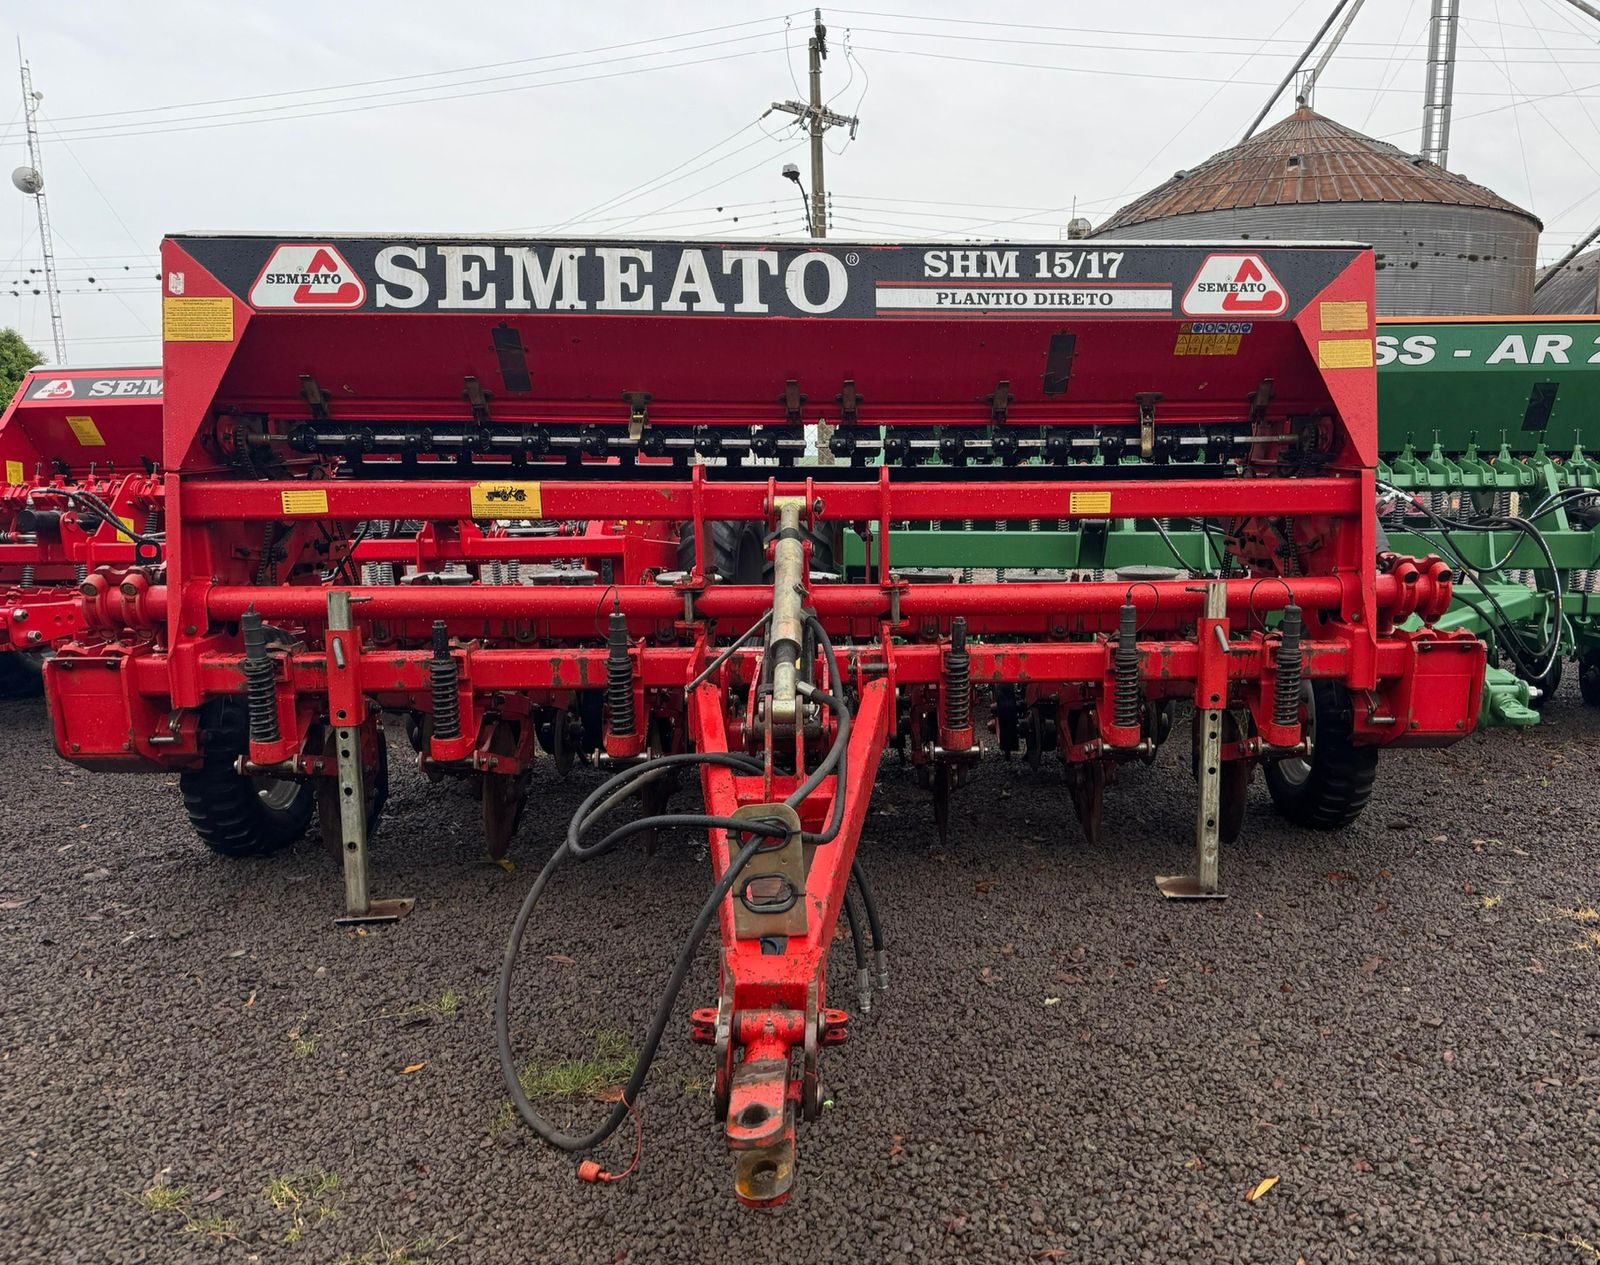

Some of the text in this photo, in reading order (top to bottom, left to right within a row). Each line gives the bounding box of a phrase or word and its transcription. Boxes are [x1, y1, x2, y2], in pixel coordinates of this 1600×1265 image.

[923, 250, 1125, 279] SHM 15/17
[266, 273, 341, 285] SEMEATO
[1198, 283, 1266, 293] SEMEATO
[936, 291, 1114, 307] PLANTIO DIRETO
[1485, 334, 1574, 364] AR
